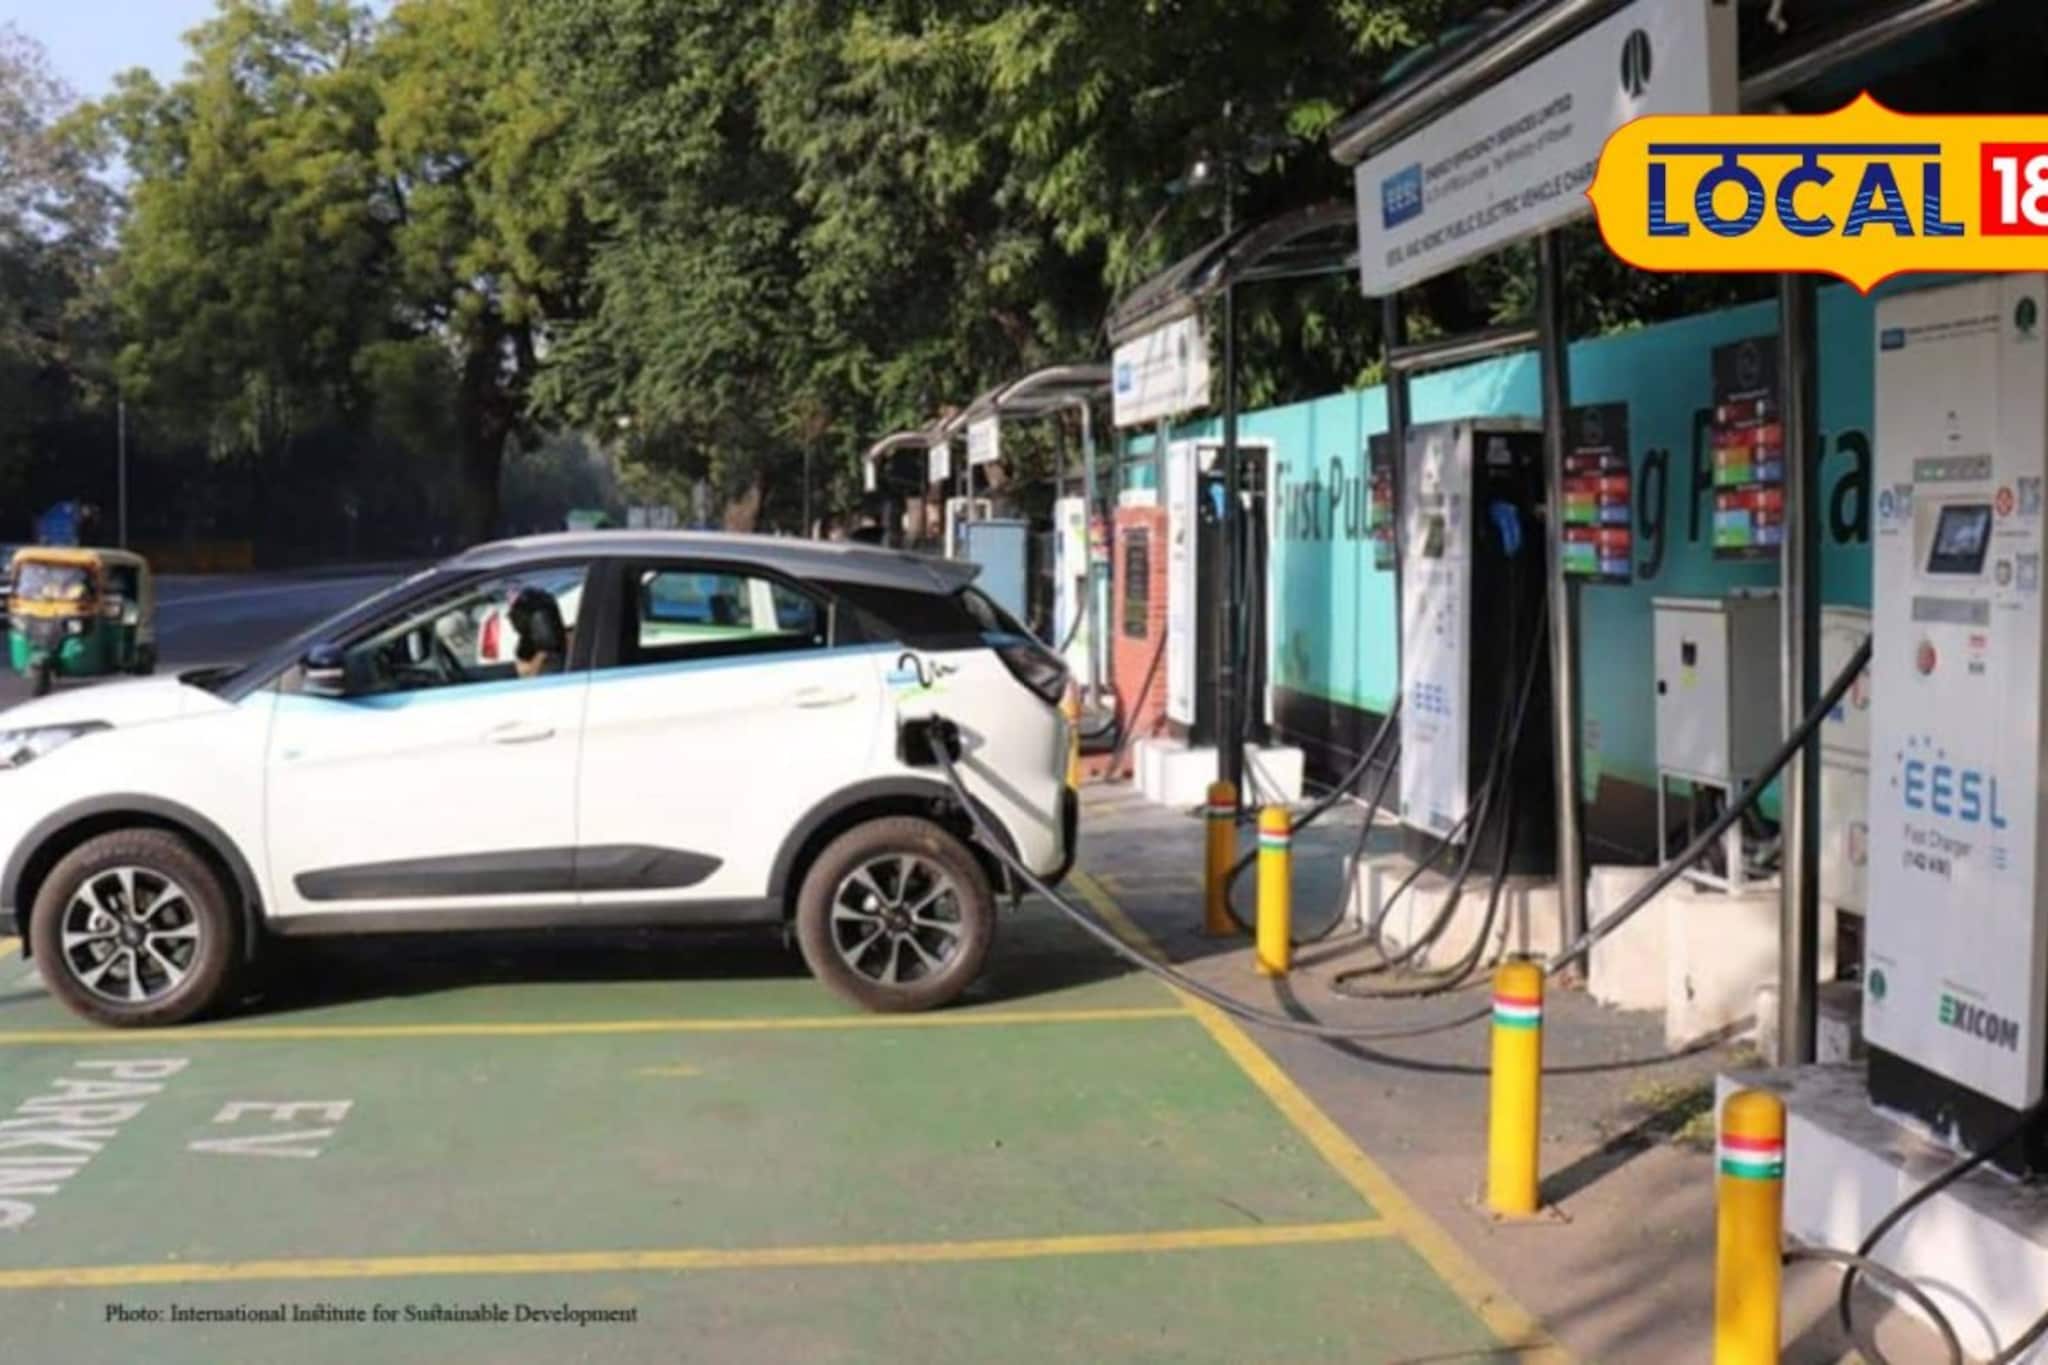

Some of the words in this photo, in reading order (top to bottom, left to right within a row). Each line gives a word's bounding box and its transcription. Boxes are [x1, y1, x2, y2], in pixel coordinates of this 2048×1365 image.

[1904, 760, 2007, 830] EESL
[1938, 992, 2020, 1053] EXICOM
[188, 1099, 356, 1159] EV
